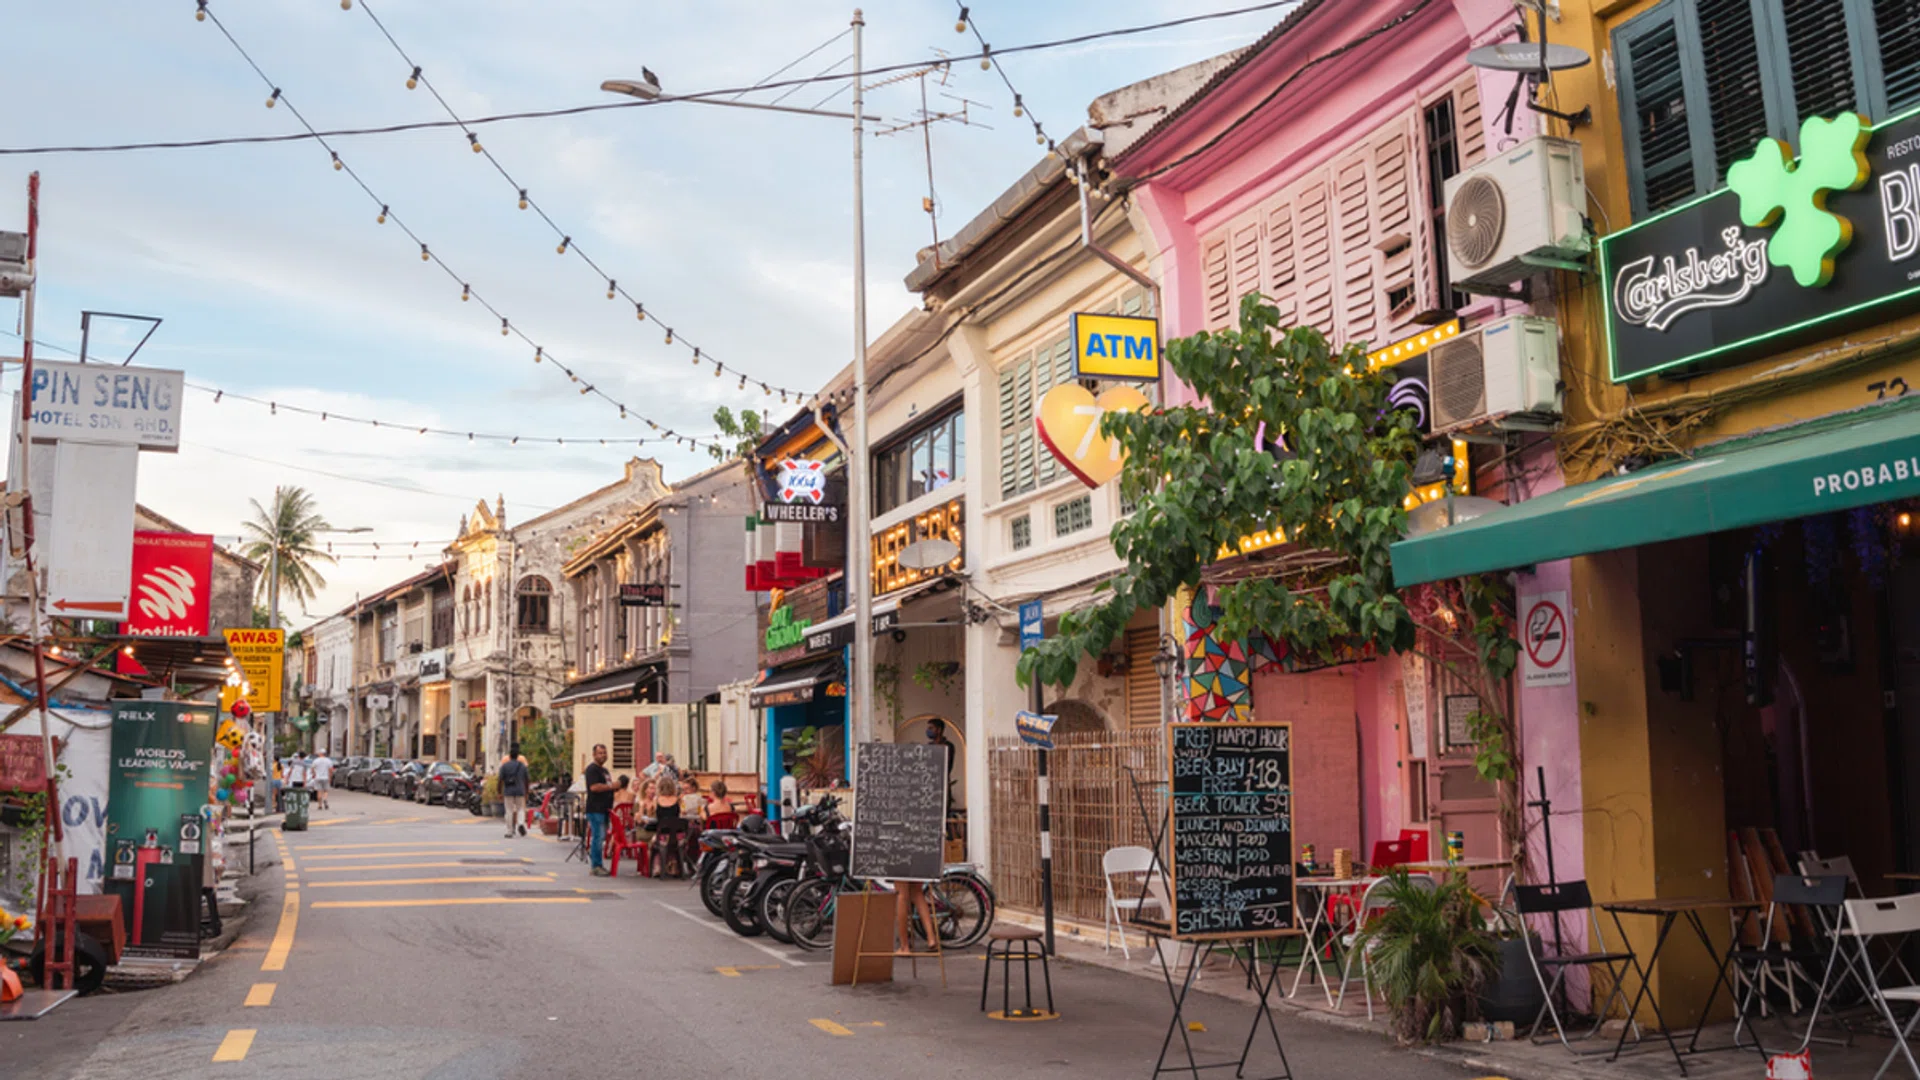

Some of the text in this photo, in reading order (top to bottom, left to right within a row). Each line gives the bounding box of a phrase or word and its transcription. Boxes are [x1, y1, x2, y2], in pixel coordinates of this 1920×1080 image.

[1614, 236, 1767, 327] Carlsberg
[1086, 333, 1153, 361] ATM
[32, 369, 172, 411] PIN SENG
[767, 505, 838, 522] WHEELER'S
[230, 632, 278, 644] AWAS
[118, 711, 156, 721] RELX
[1174, 728, 1288, 748] FREE HAPPY HOUR
[135, 748, 185, 759] WORLD'S
[118, 758, 167, 769] LEADING
[1175, 758, 1213, 777] BEER
[1216, 757, 1245, 778] BUY
[1202, 776, 1238, 794] FREE
[1174, 793, 1289, 815] BEER TOWER 59
[1175, 817, 1220, 832] LUNCH
[1175, 833, 1268, 847] MAXICAN FOOD
[1175, 848, 1270, 865] WESTERN FOOD
[1177, 864, 1223, 879] INDIAN
[1179, 908, 1244, 932] SHISHA
[1252, 908, 1278, 925] 30
